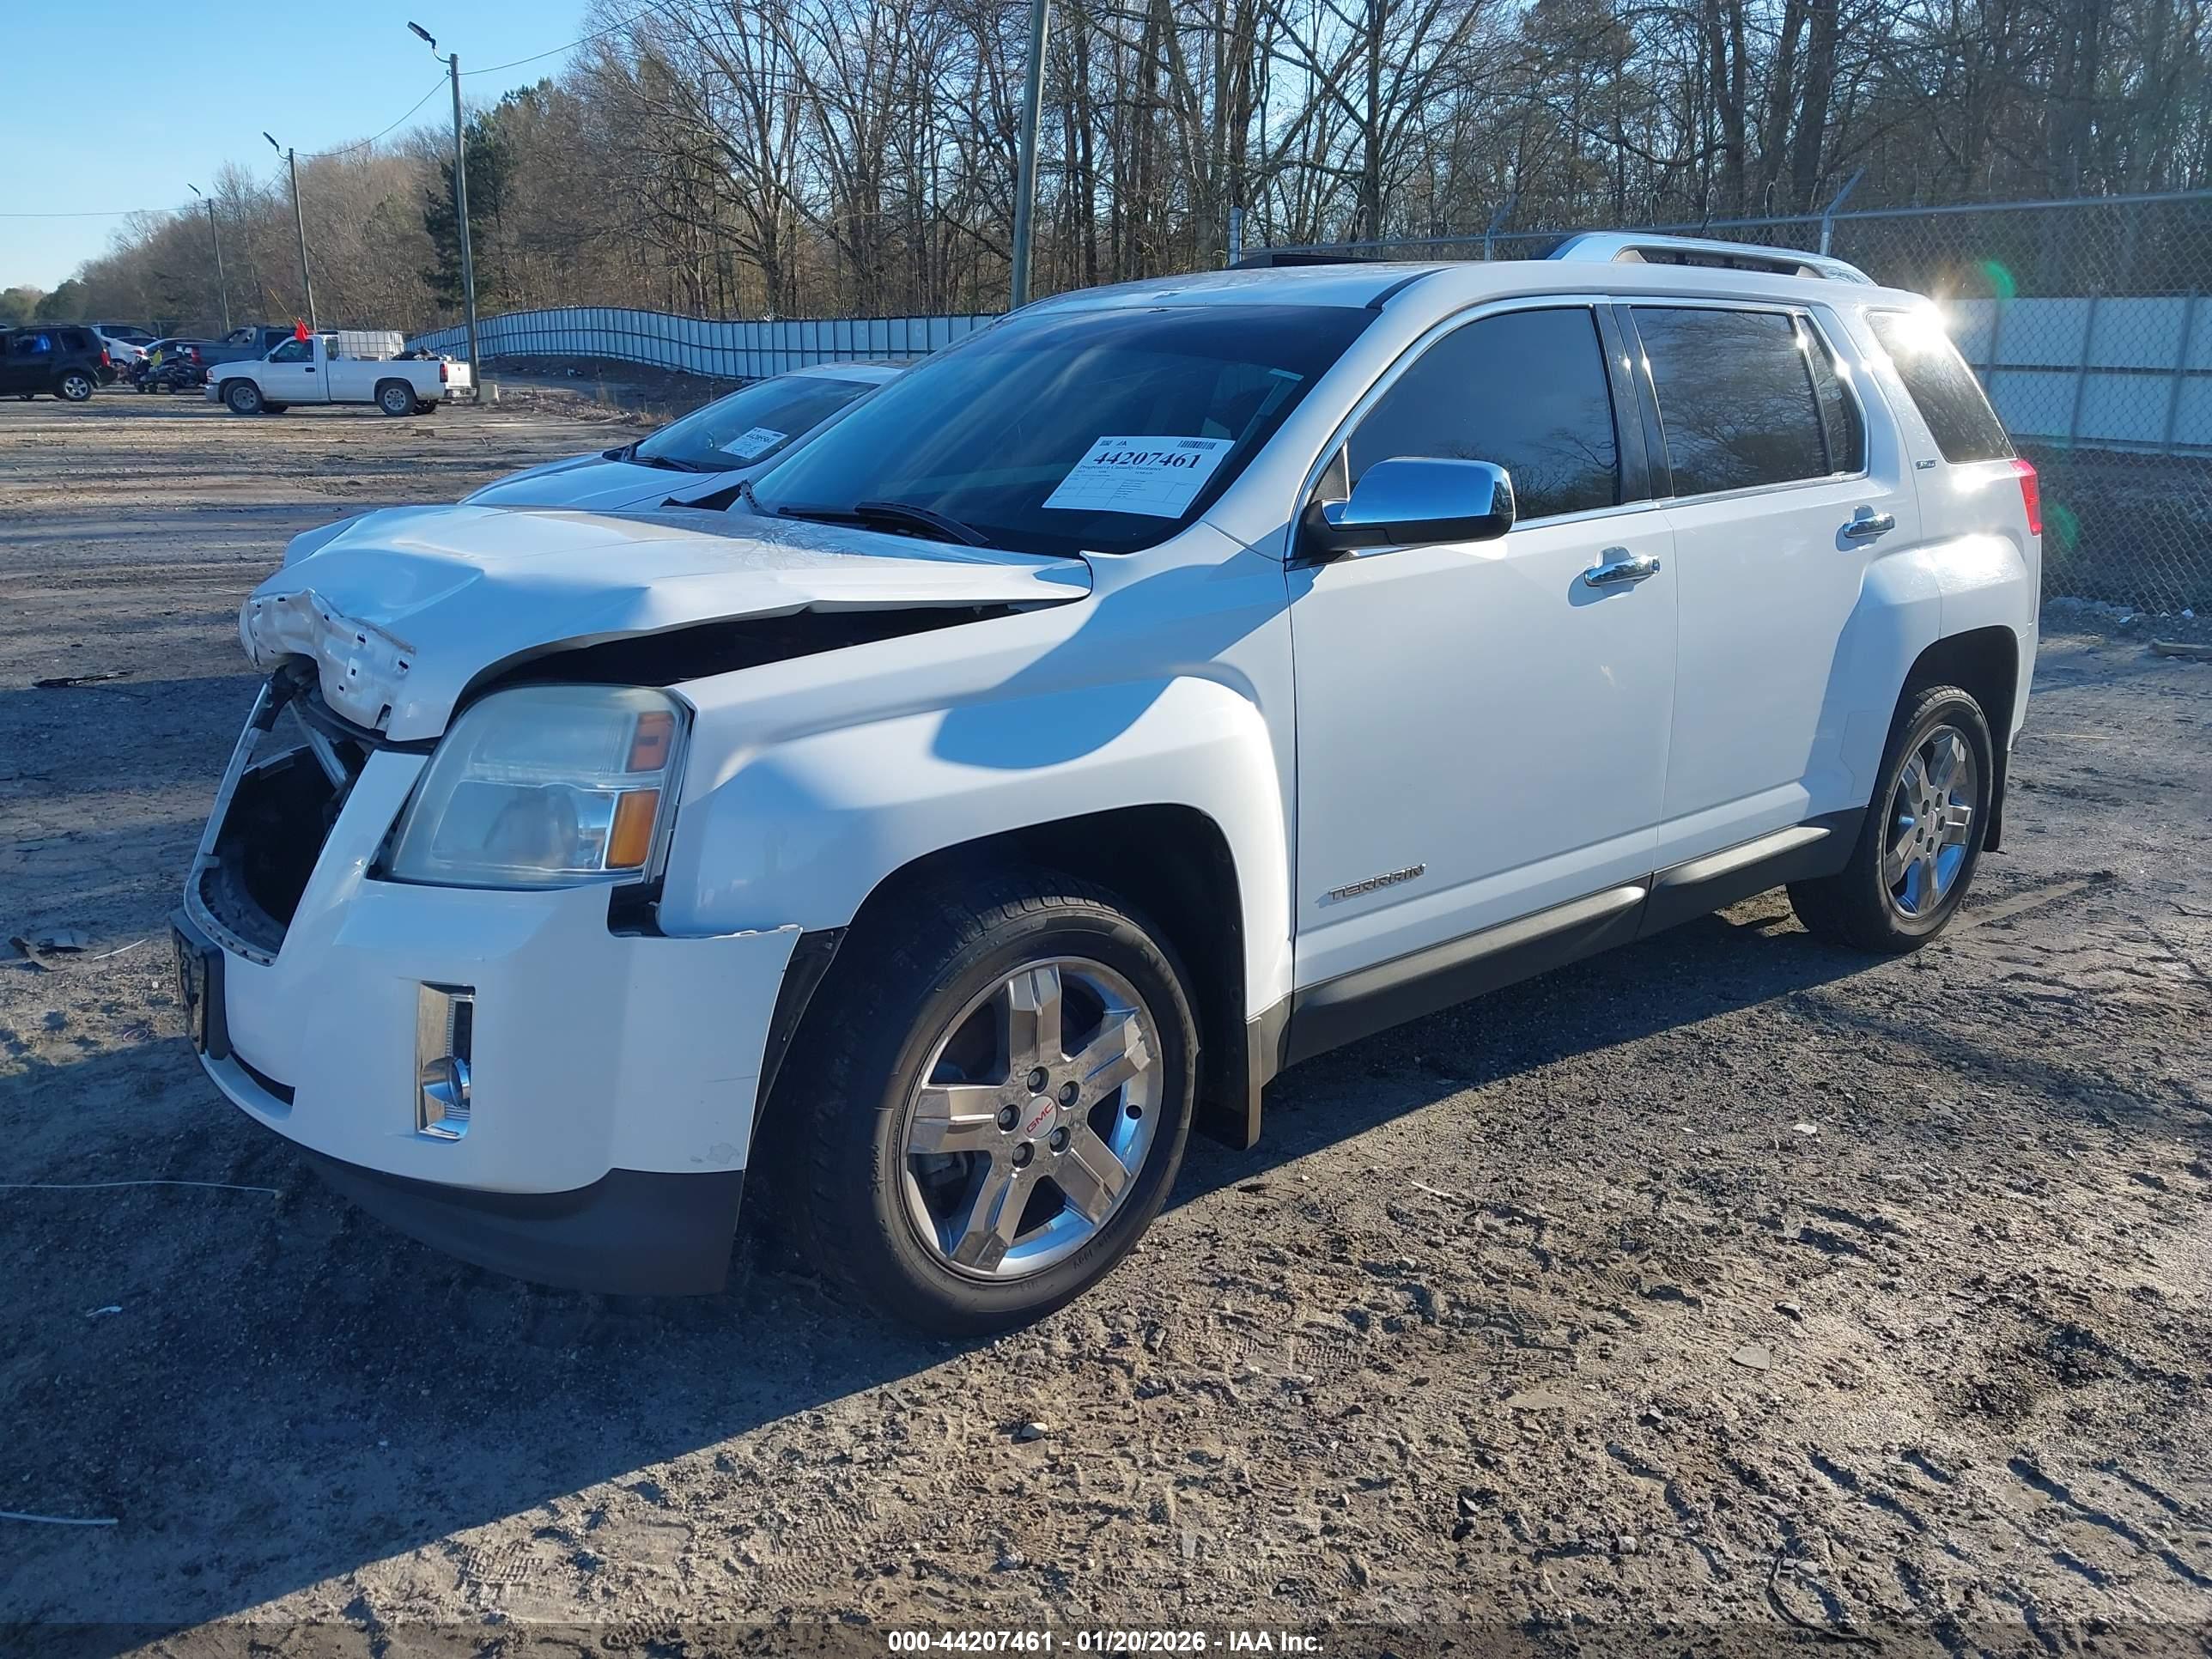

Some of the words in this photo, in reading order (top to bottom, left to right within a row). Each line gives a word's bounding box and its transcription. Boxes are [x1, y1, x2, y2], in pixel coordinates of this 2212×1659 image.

[1093, 452, 1202, 469] 44207461
[1328, 862, 1426, 900] TERRAIN
[1026, 1102, 1054, 1133] GMC
